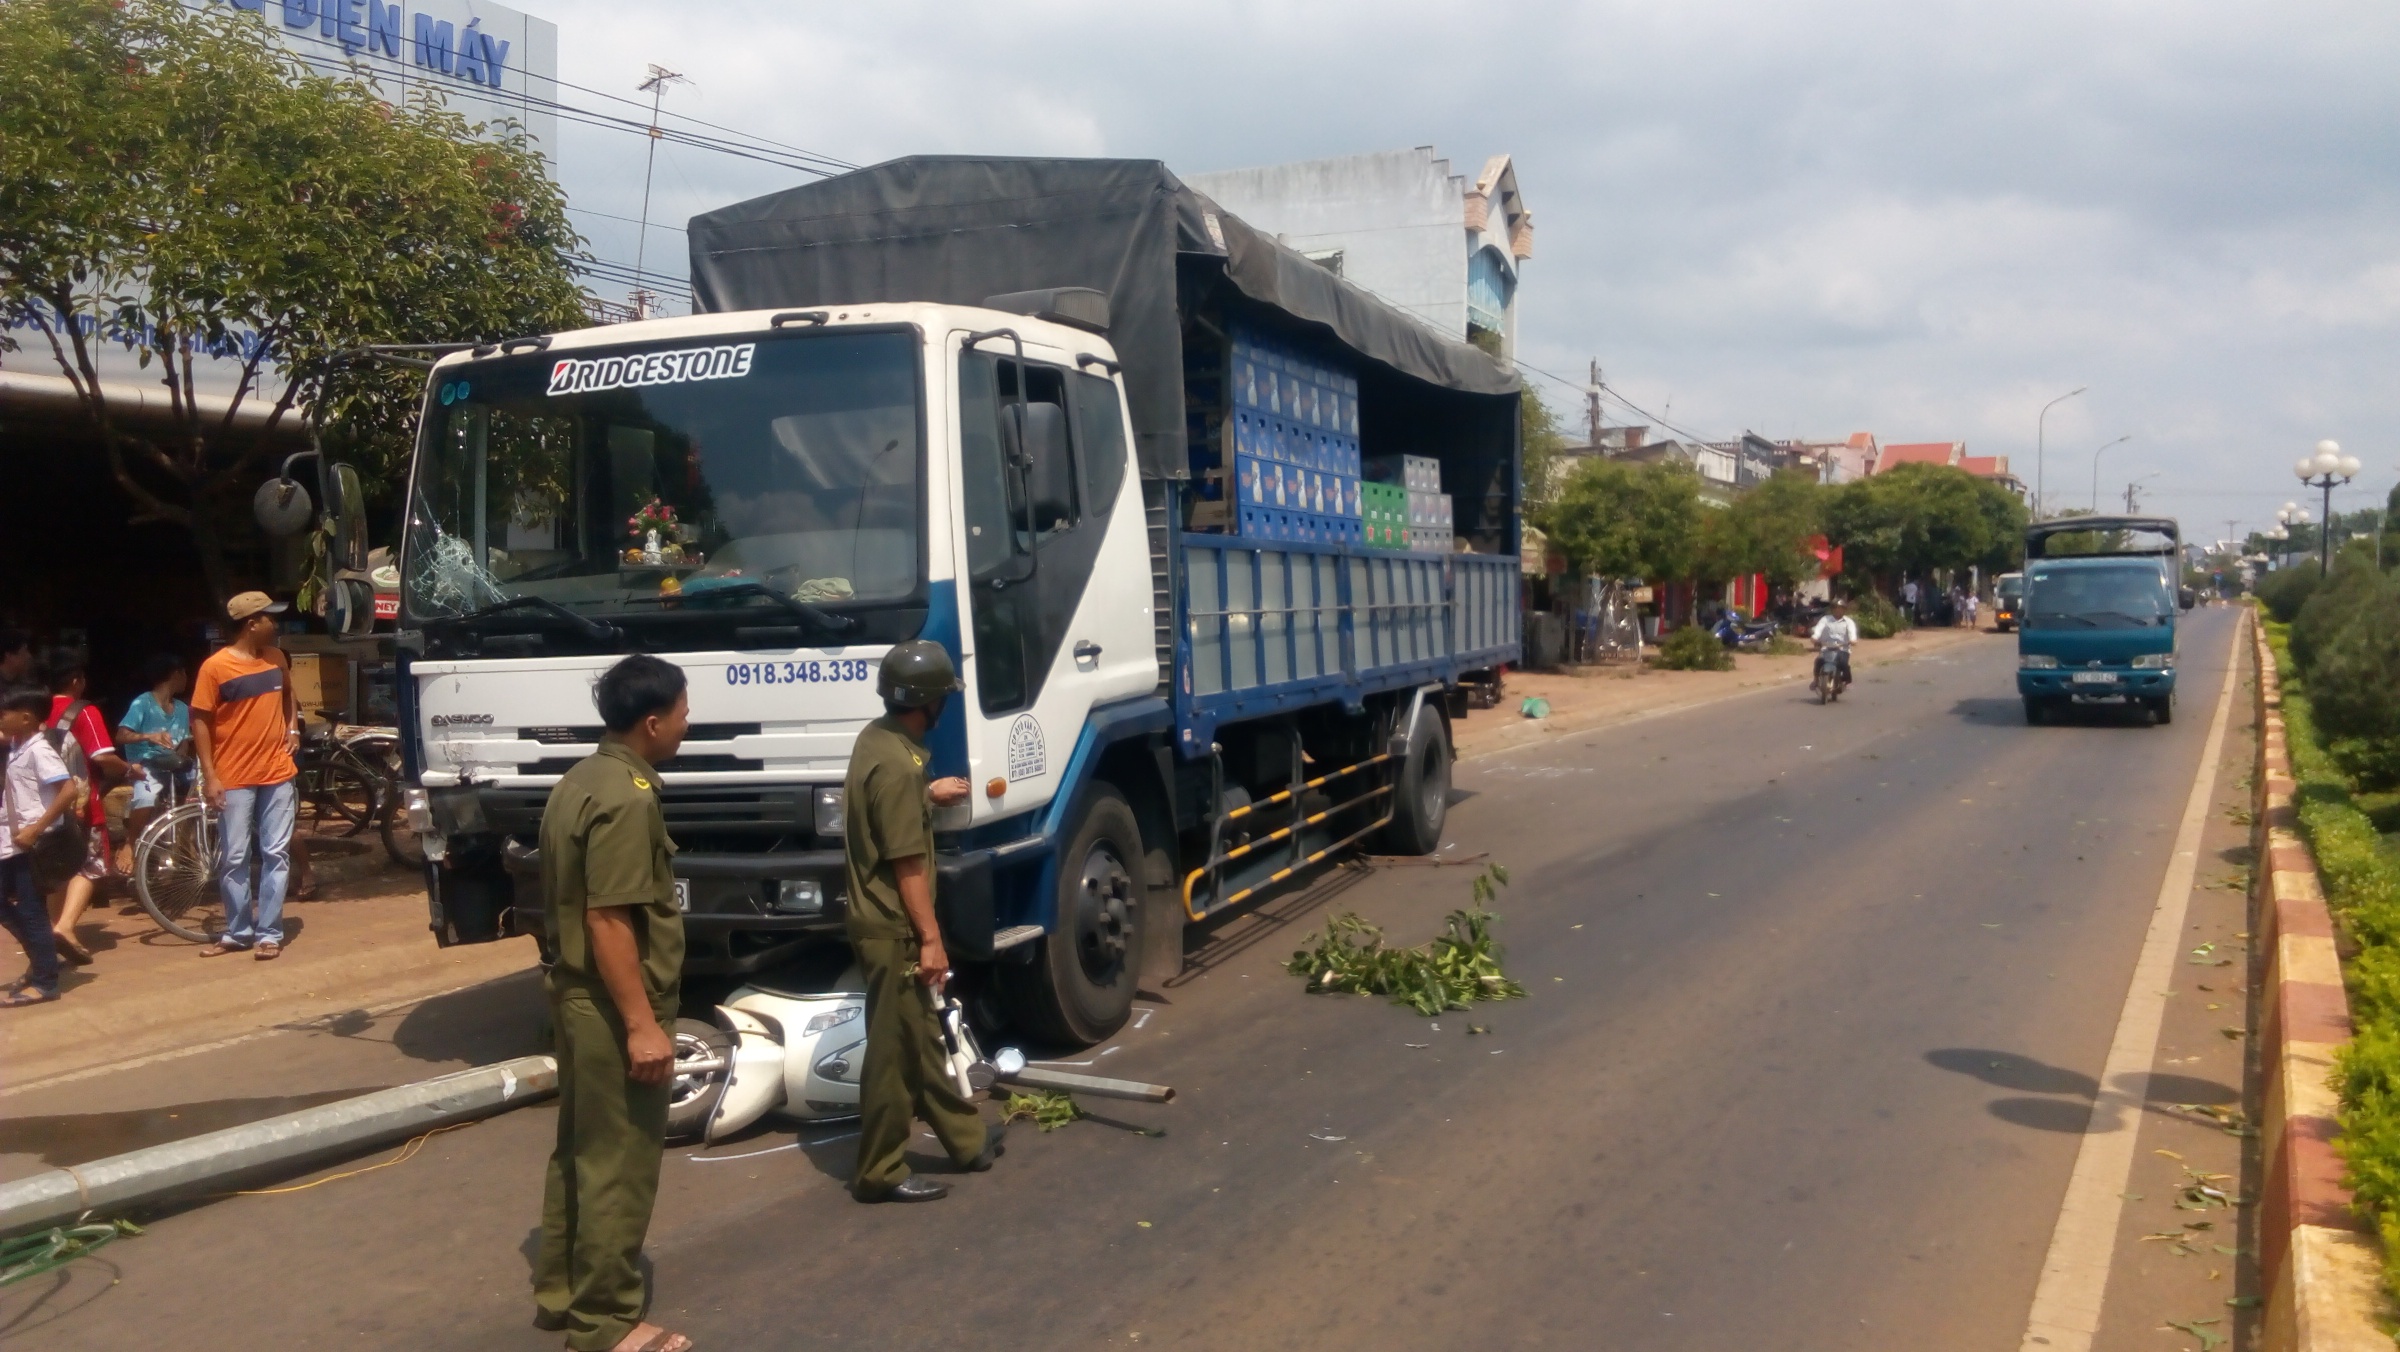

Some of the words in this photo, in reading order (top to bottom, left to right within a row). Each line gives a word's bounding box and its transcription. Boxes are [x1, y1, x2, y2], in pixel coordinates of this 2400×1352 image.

[414, 16, 511, 88] MÁY
[547, 343, 756, 396] BRIDGESTONE
[726, 659, 868, 685] 0918.348.338
